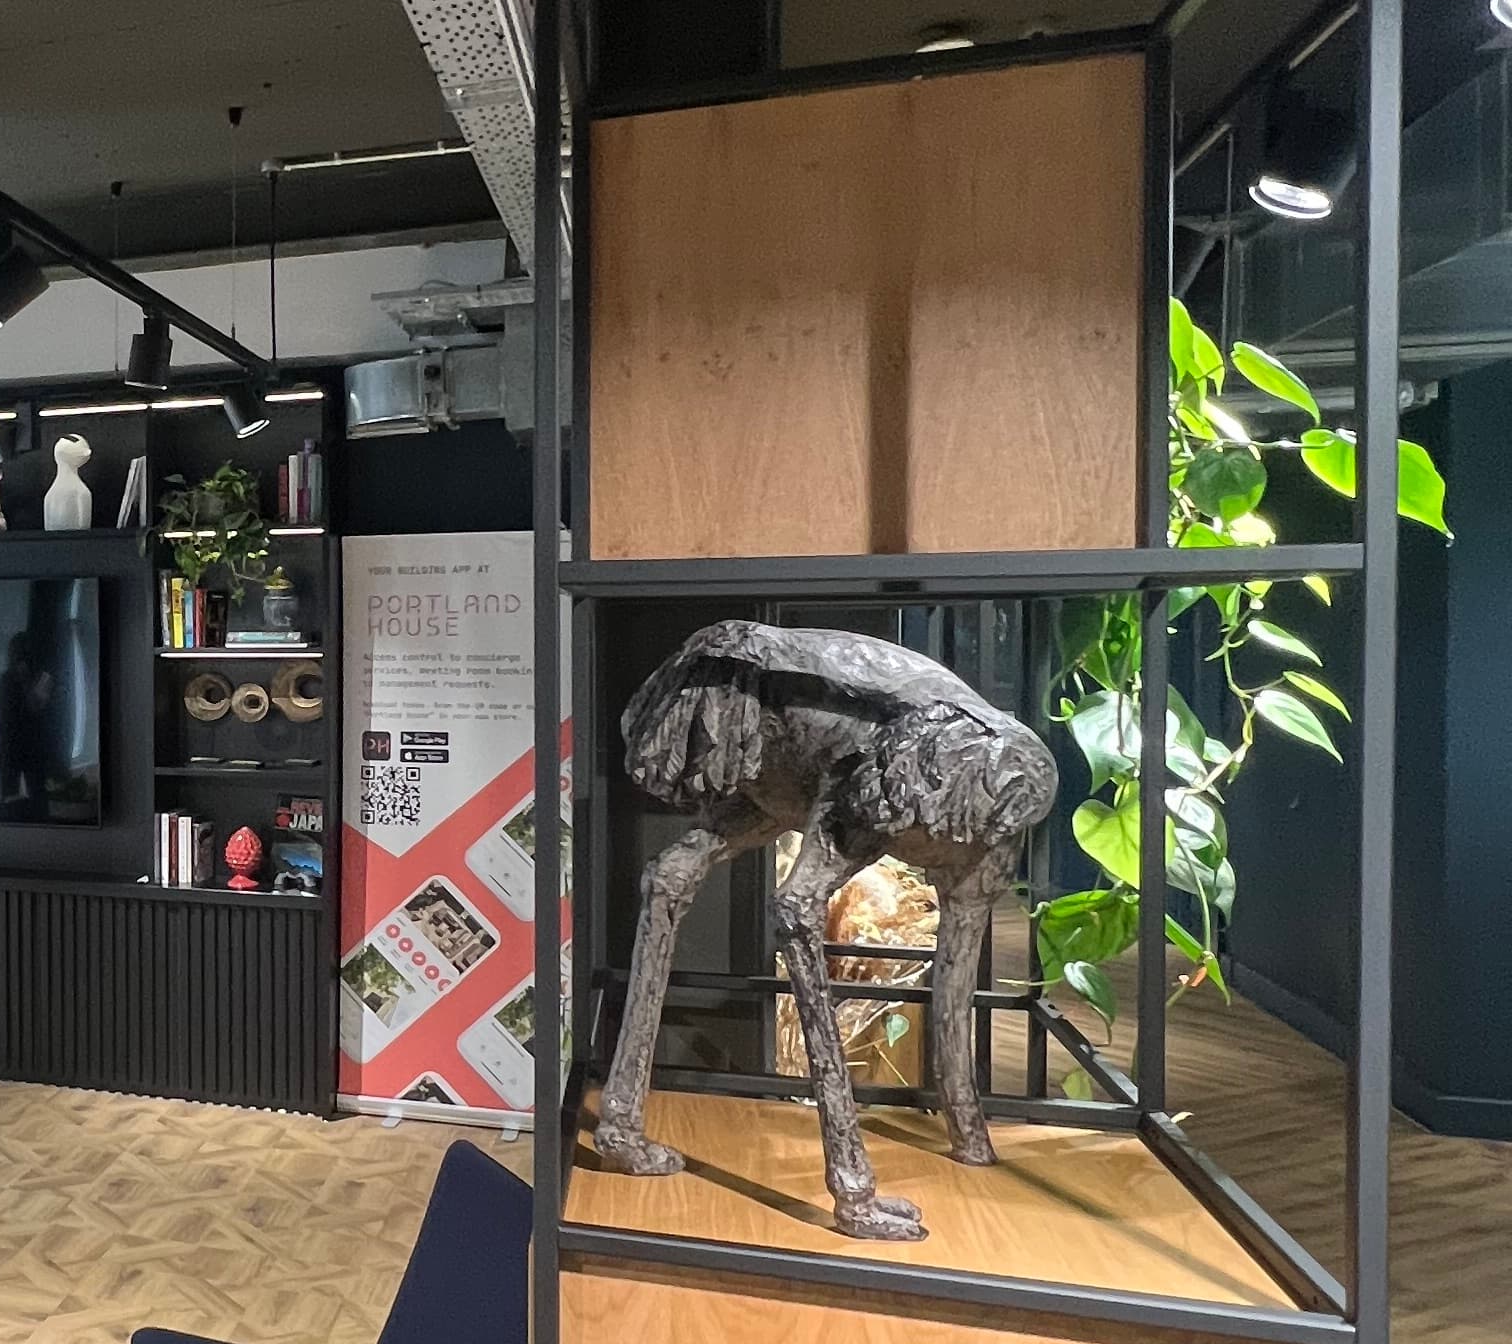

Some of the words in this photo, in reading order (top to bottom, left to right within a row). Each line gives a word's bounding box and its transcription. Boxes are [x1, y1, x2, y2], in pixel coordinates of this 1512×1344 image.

[398, 565, 446, 575] BUILDING
[453, 565, 471, 574] APP
[478, 564, 491, 574] AT
[367, 594, 521, 614] PORTLAND
[367, 617, 460, 637] HOUSE
